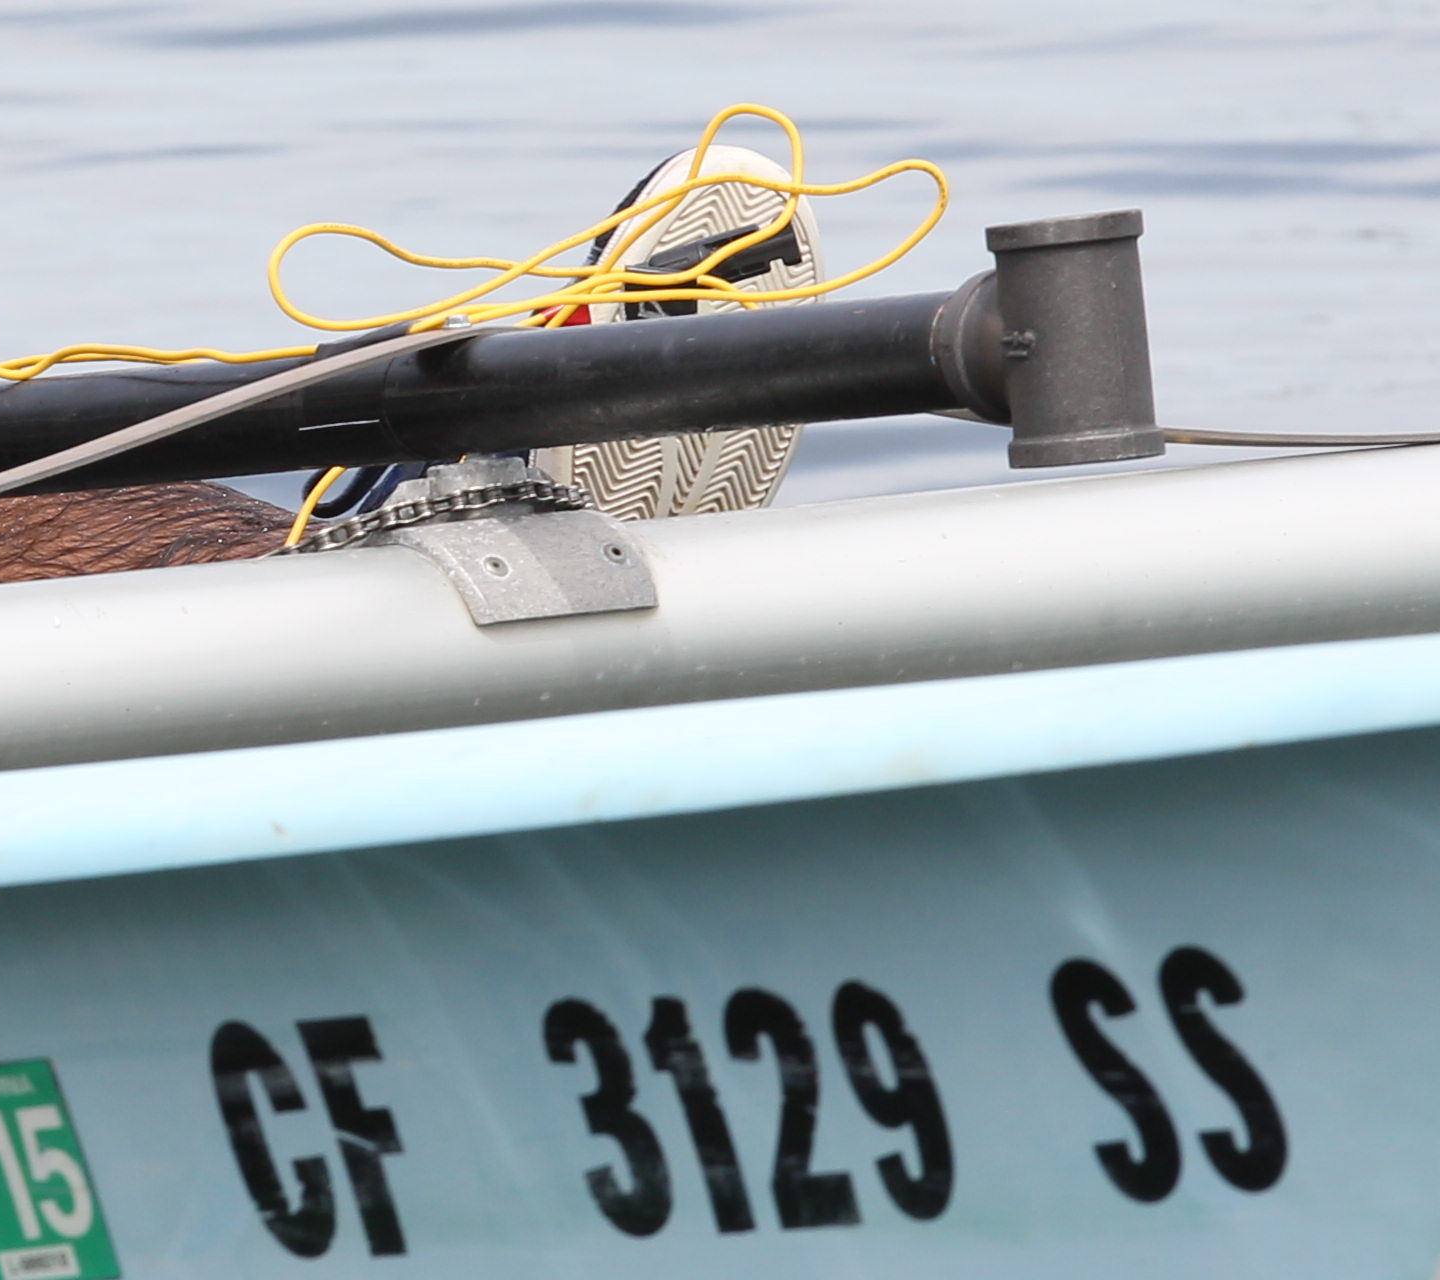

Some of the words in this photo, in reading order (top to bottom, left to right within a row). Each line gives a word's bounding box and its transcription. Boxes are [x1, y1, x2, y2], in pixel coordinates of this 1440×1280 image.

[210, 1015, 408, 1258] CF
[542, 980, 955, 1238] 3129
[1048, 945, 1289, 1203] SS
